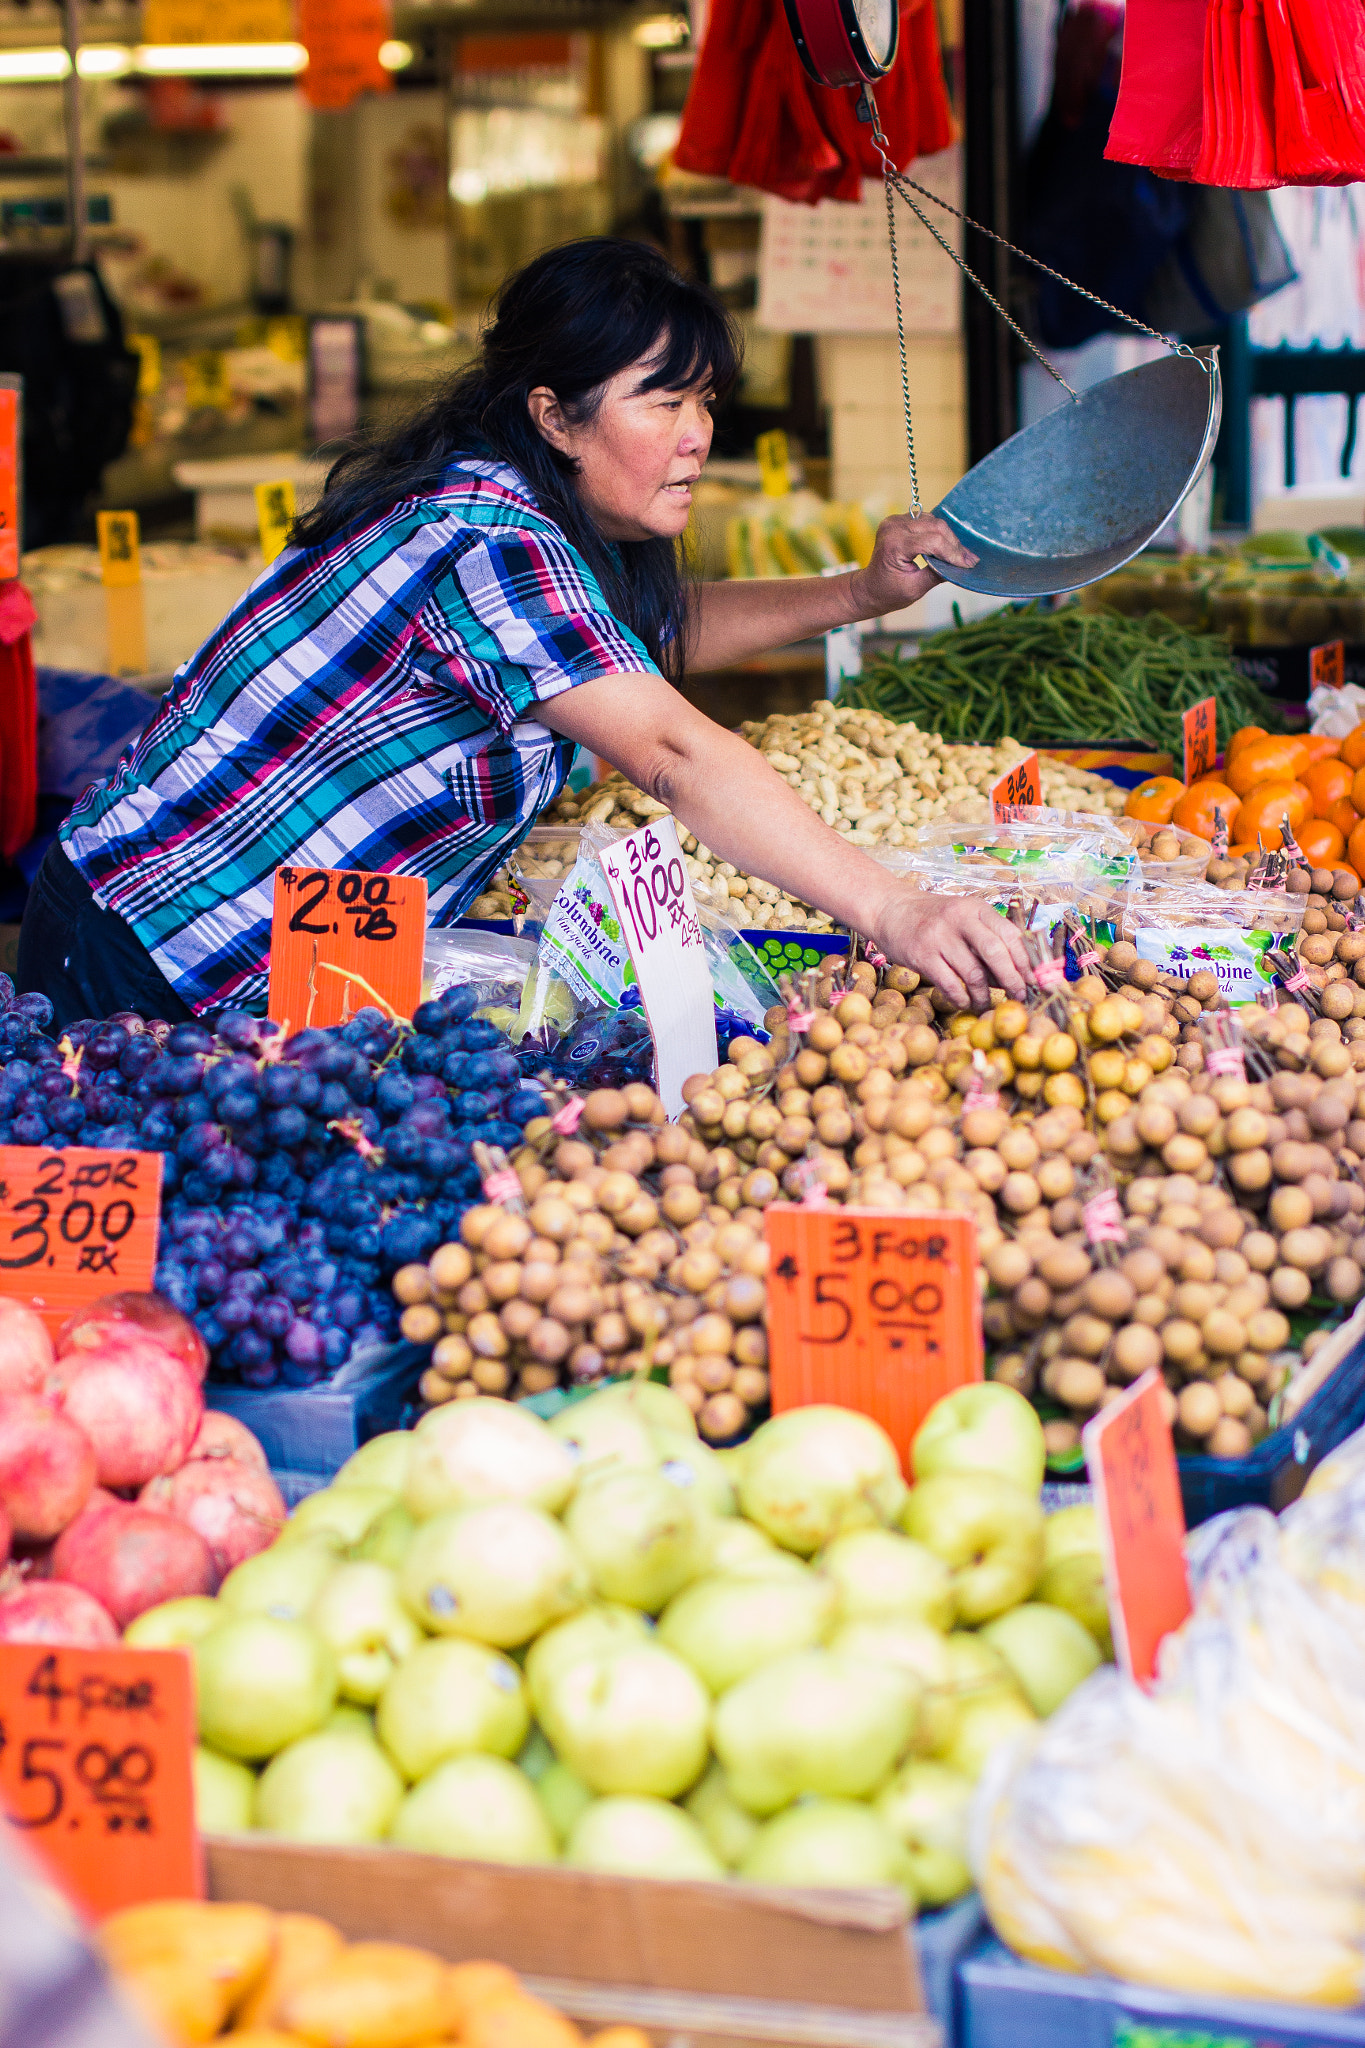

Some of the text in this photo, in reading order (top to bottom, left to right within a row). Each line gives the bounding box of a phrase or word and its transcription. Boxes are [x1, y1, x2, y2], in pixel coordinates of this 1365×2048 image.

[556, 912, 595, 960] Vineyards
[33, 1157, 138, 1199] 2 FOR
[834, 1220, 863, 1263] 3
[26, 1654, 61, 1724] 4
[0, 1718, 157, 1832] 5.00
